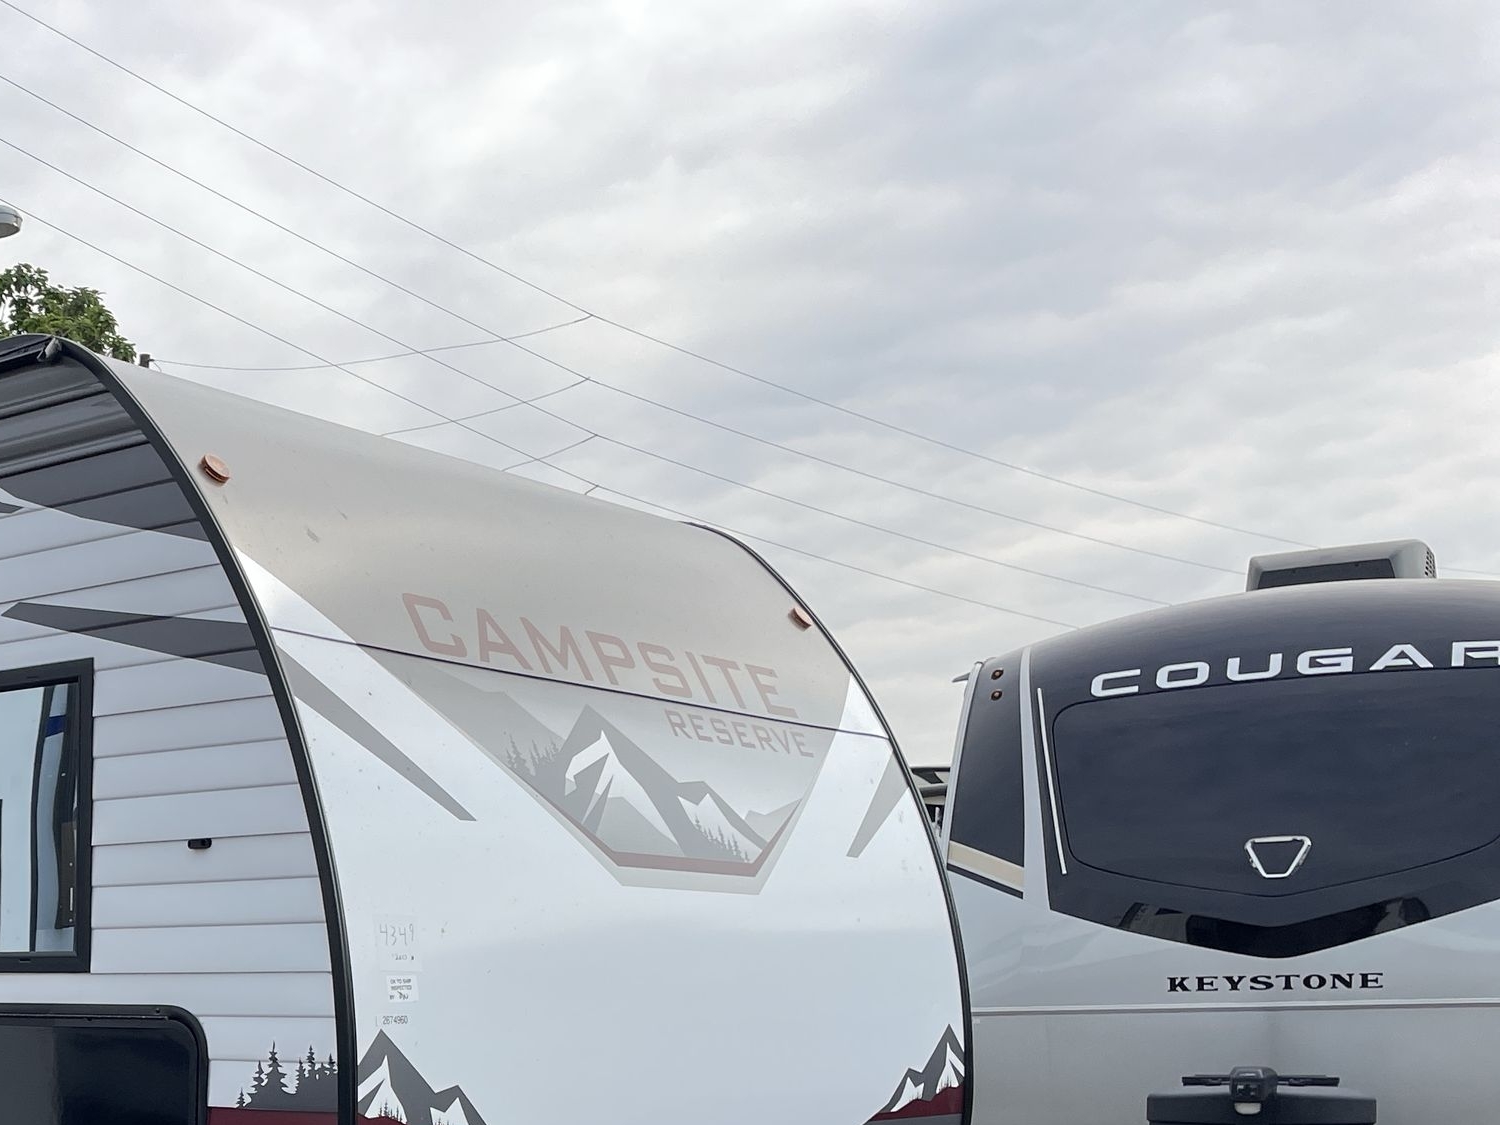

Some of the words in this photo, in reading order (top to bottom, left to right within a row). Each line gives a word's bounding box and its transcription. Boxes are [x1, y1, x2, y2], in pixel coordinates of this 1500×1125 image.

[402, 593, 799, 719] CAMPSITE
[1090, 640, 1500, 698] COUGAR
[665, 708, 815, 759] RESERVE
[1167, 972, 1384, 993] KEYSTONE
